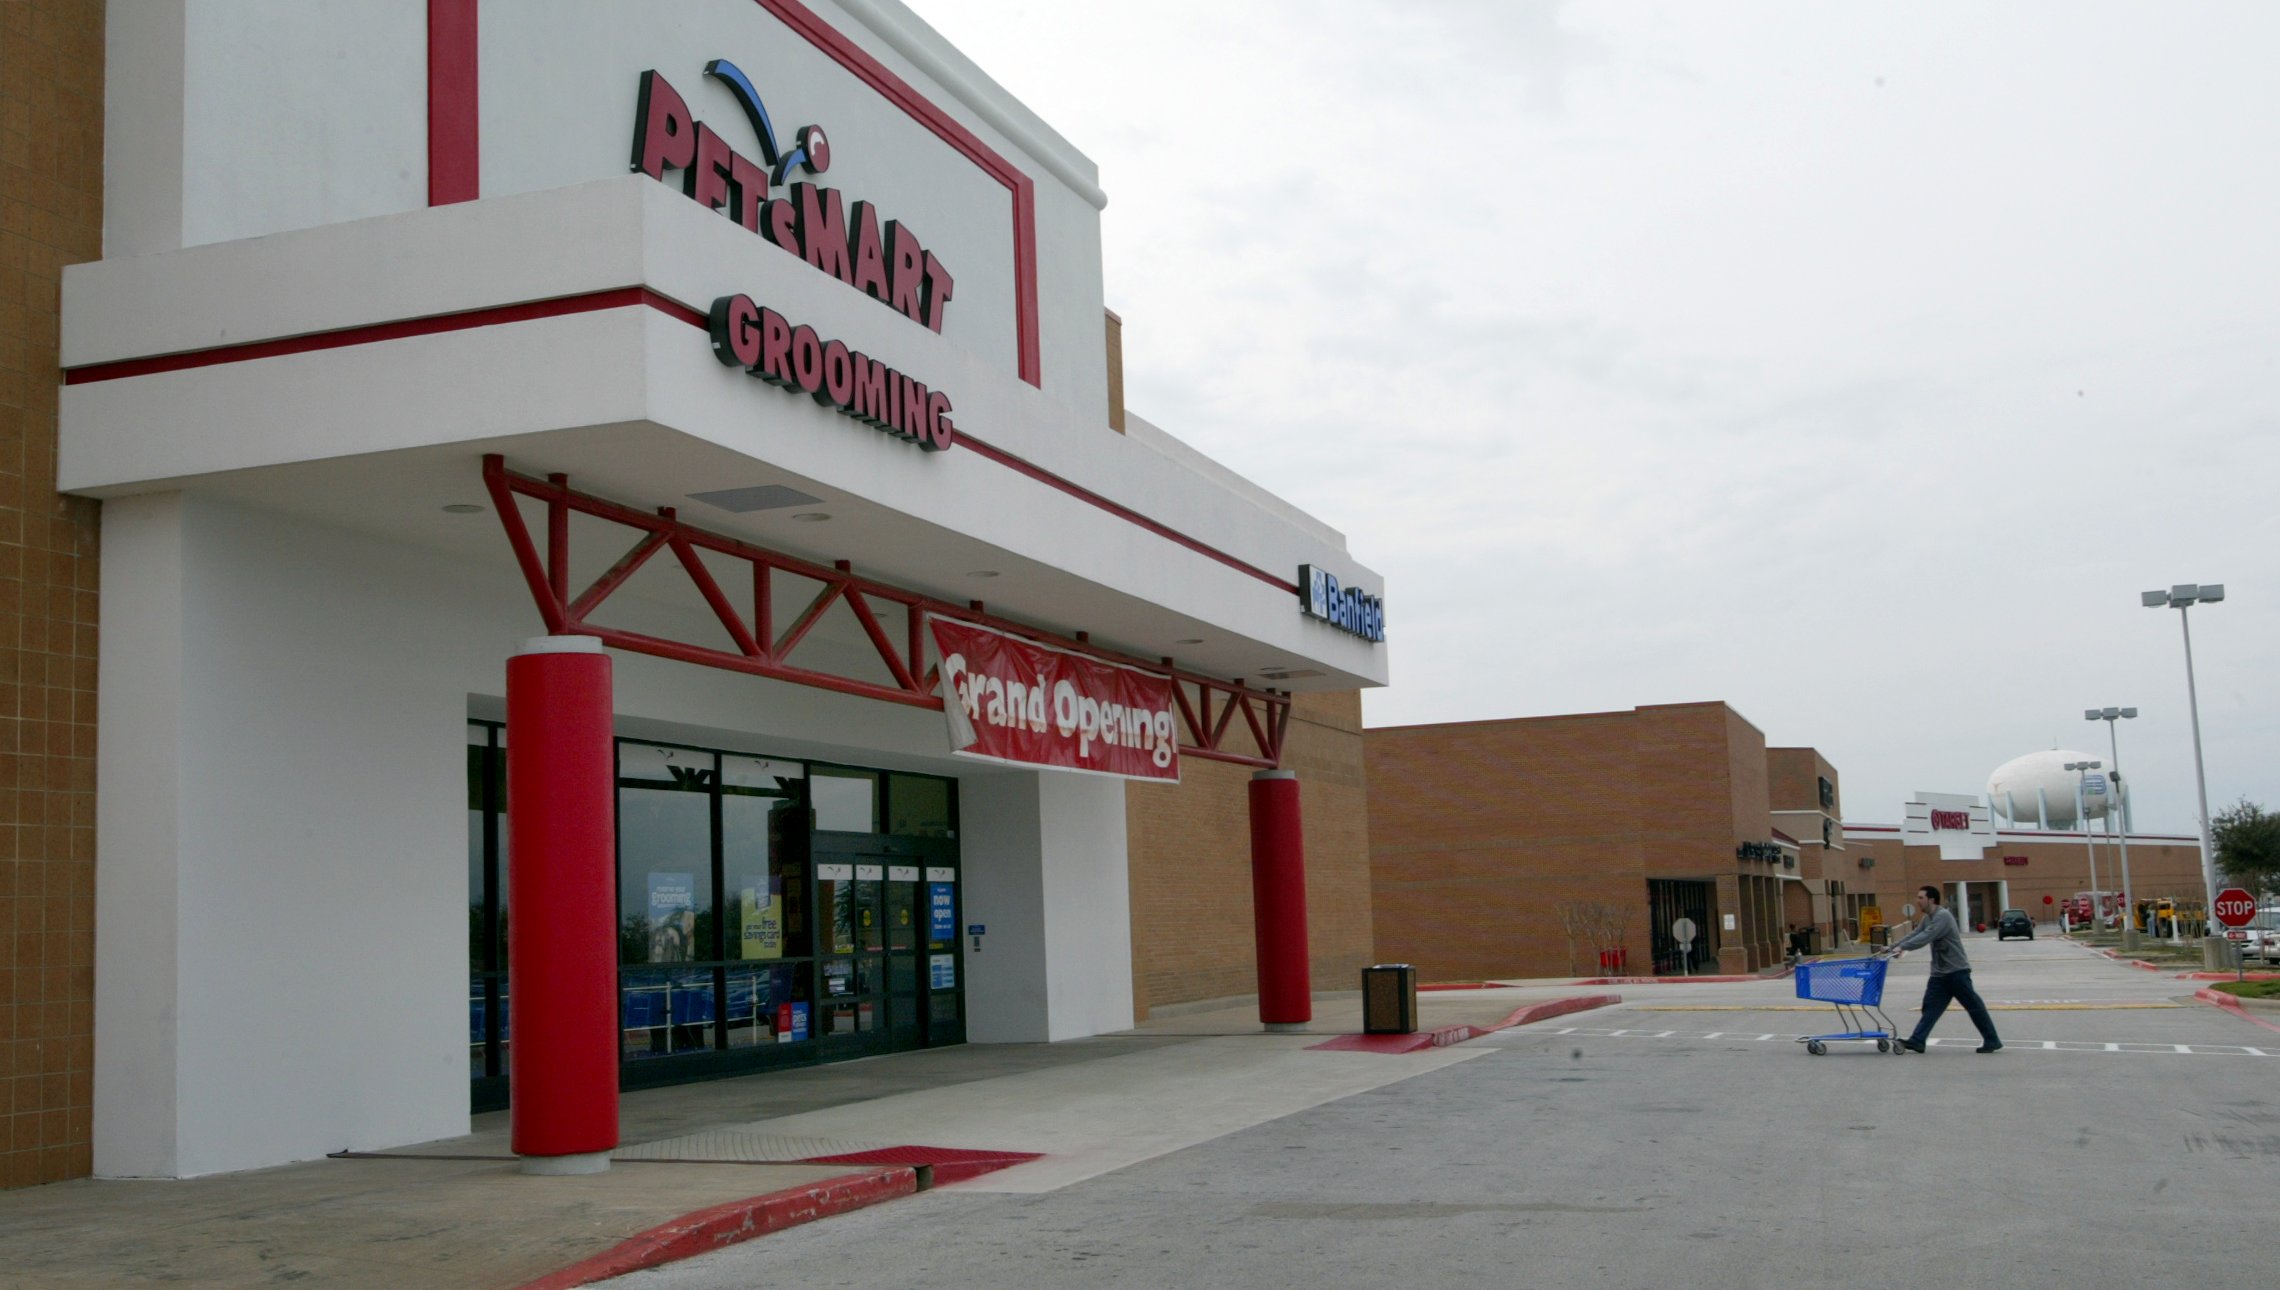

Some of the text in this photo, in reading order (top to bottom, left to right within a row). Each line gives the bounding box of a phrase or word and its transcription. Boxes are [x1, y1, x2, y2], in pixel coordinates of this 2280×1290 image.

[715, 293, 953, 451] GROOMING
[1327, 573, 1384, 642] Banfield
[1940, 811, 1969, 830] TARGET
[933, 895, 950, 905] now
[2216, 900, 2254, 916] STOP
[933, 909, 952, 922] open
